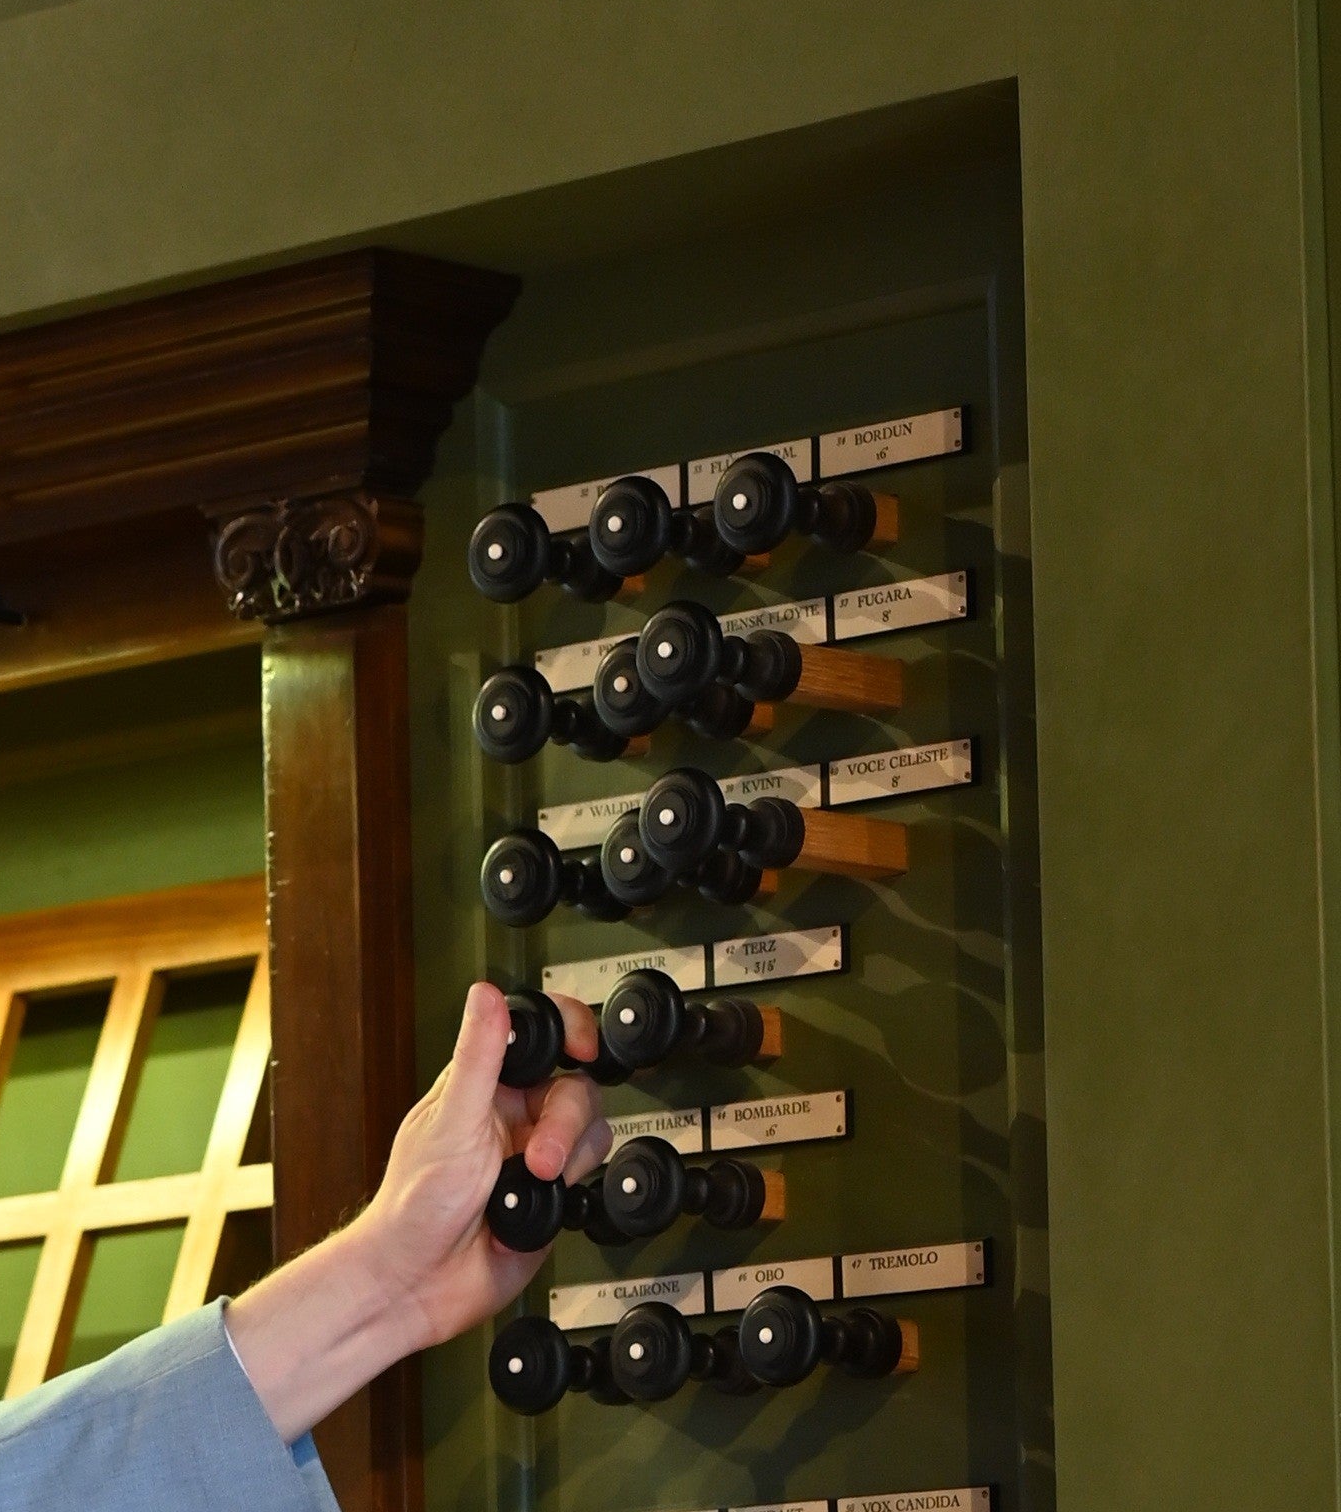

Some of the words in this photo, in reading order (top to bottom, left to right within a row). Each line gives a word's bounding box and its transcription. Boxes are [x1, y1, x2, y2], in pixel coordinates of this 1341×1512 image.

[854, 422, 913, 446] BORDUN
[857, 588, 913, 608] FUGARA
[847, 758, 885, 776] VOCE
[889, 747, 949, 770] CELESTE
[742, 776, 783, 794] KVINT
[742, 939, 777, 957] TERZ
[617, 956, 666, 974] MIXTUR
[734, 1100, 811, 1122] BOMBARDE
[868, 1251, 939, 1270] TREMOLO
[755, 1268, 785, 1283] OBO
[613, 1280, 681, 1300] CLAIRONE
[895, 1494, 961, 1512] CANDIDA
